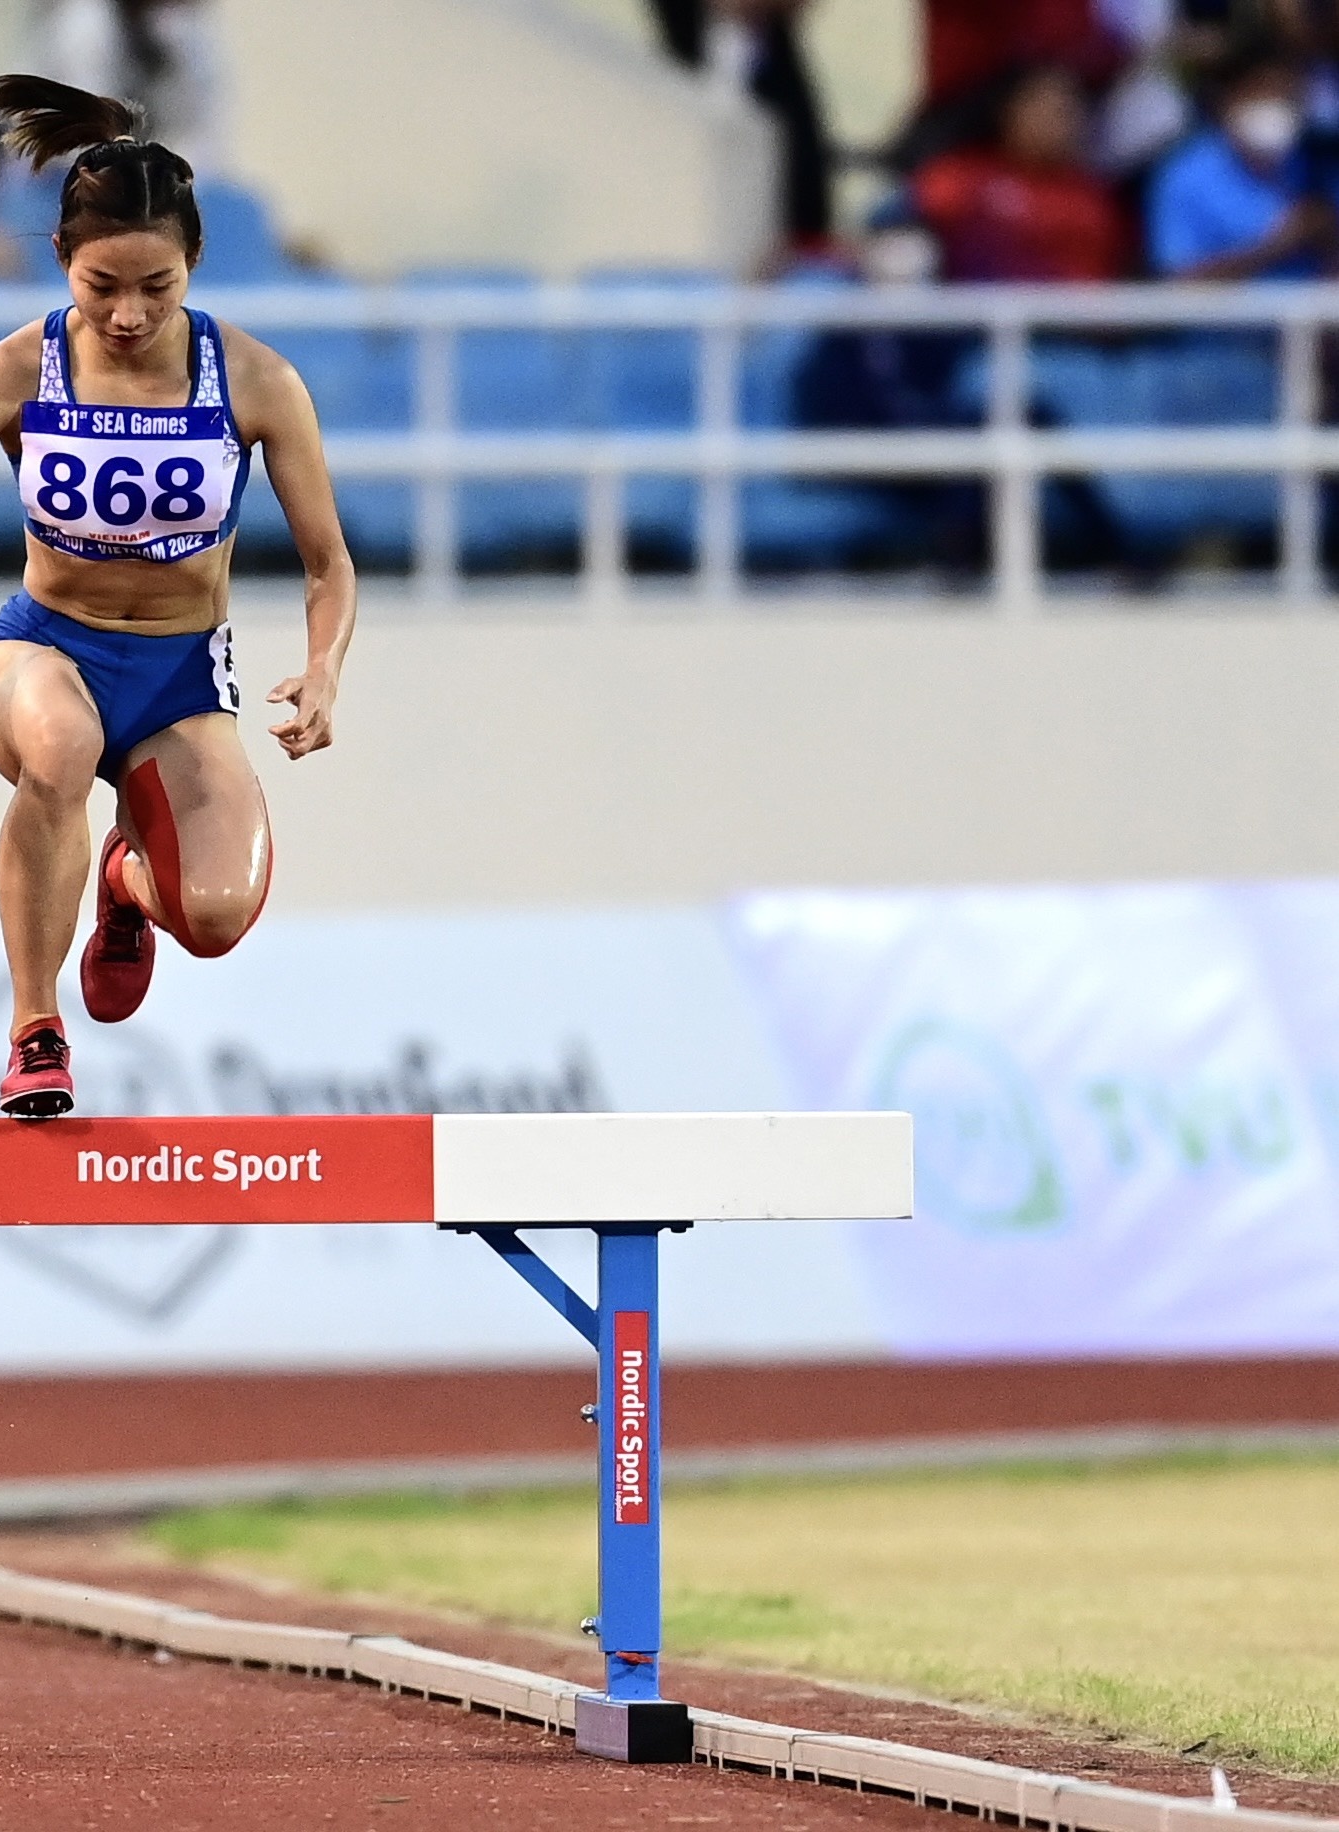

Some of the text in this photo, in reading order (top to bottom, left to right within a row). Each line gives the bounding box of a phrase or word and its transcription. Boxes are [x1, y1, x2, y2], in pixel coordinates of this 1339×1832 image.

[92, 411, 125, 434] SEA
[130, 414, 188, 435] Games
[36, 452, 206, 526] 868
[88, 530, 151, 542] VIETNAM
[167, 533, 204, 557] 2022
[212, 1148, 322, 1191] Sport
[616, 1435, 643, 1506] Sport
